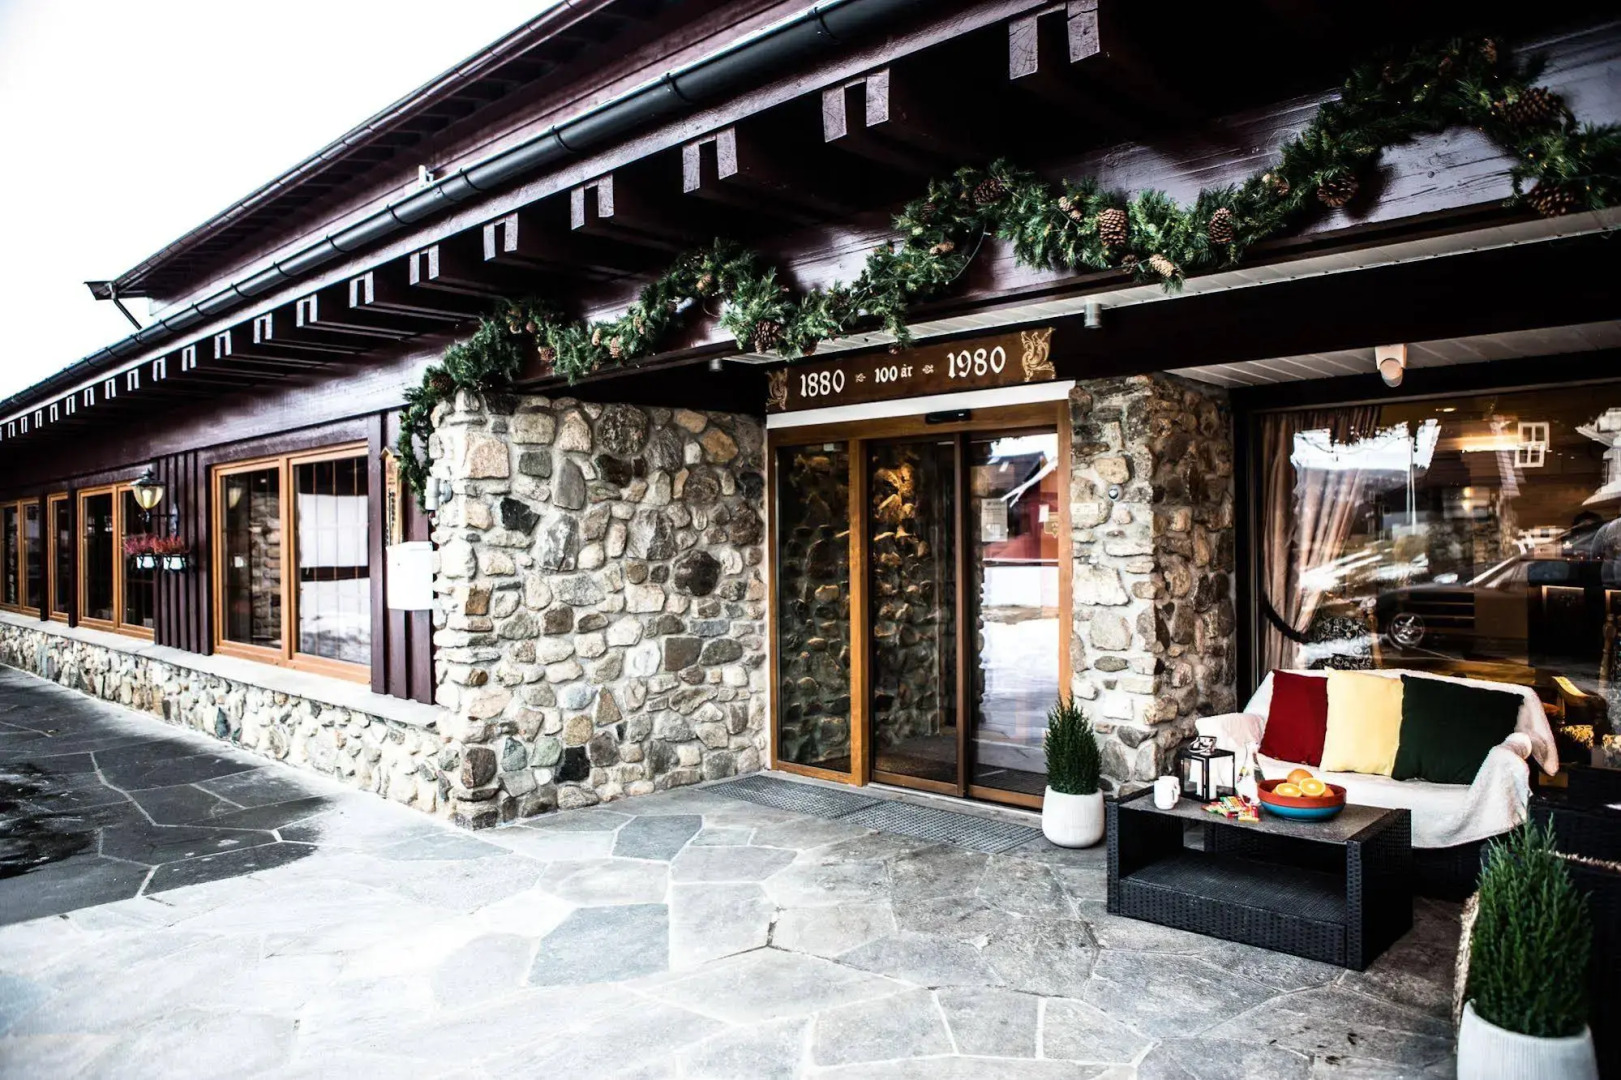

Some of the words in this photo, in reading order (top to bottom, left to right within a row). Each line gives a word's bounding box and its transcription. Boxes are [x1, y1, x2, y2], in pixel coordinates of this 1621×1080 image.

[800, 369, 845, 398] 1880
[874, 365, 898, 384] 100
[901, 363, 914, 378] år
[946, 345, 1007, 379] 1980
